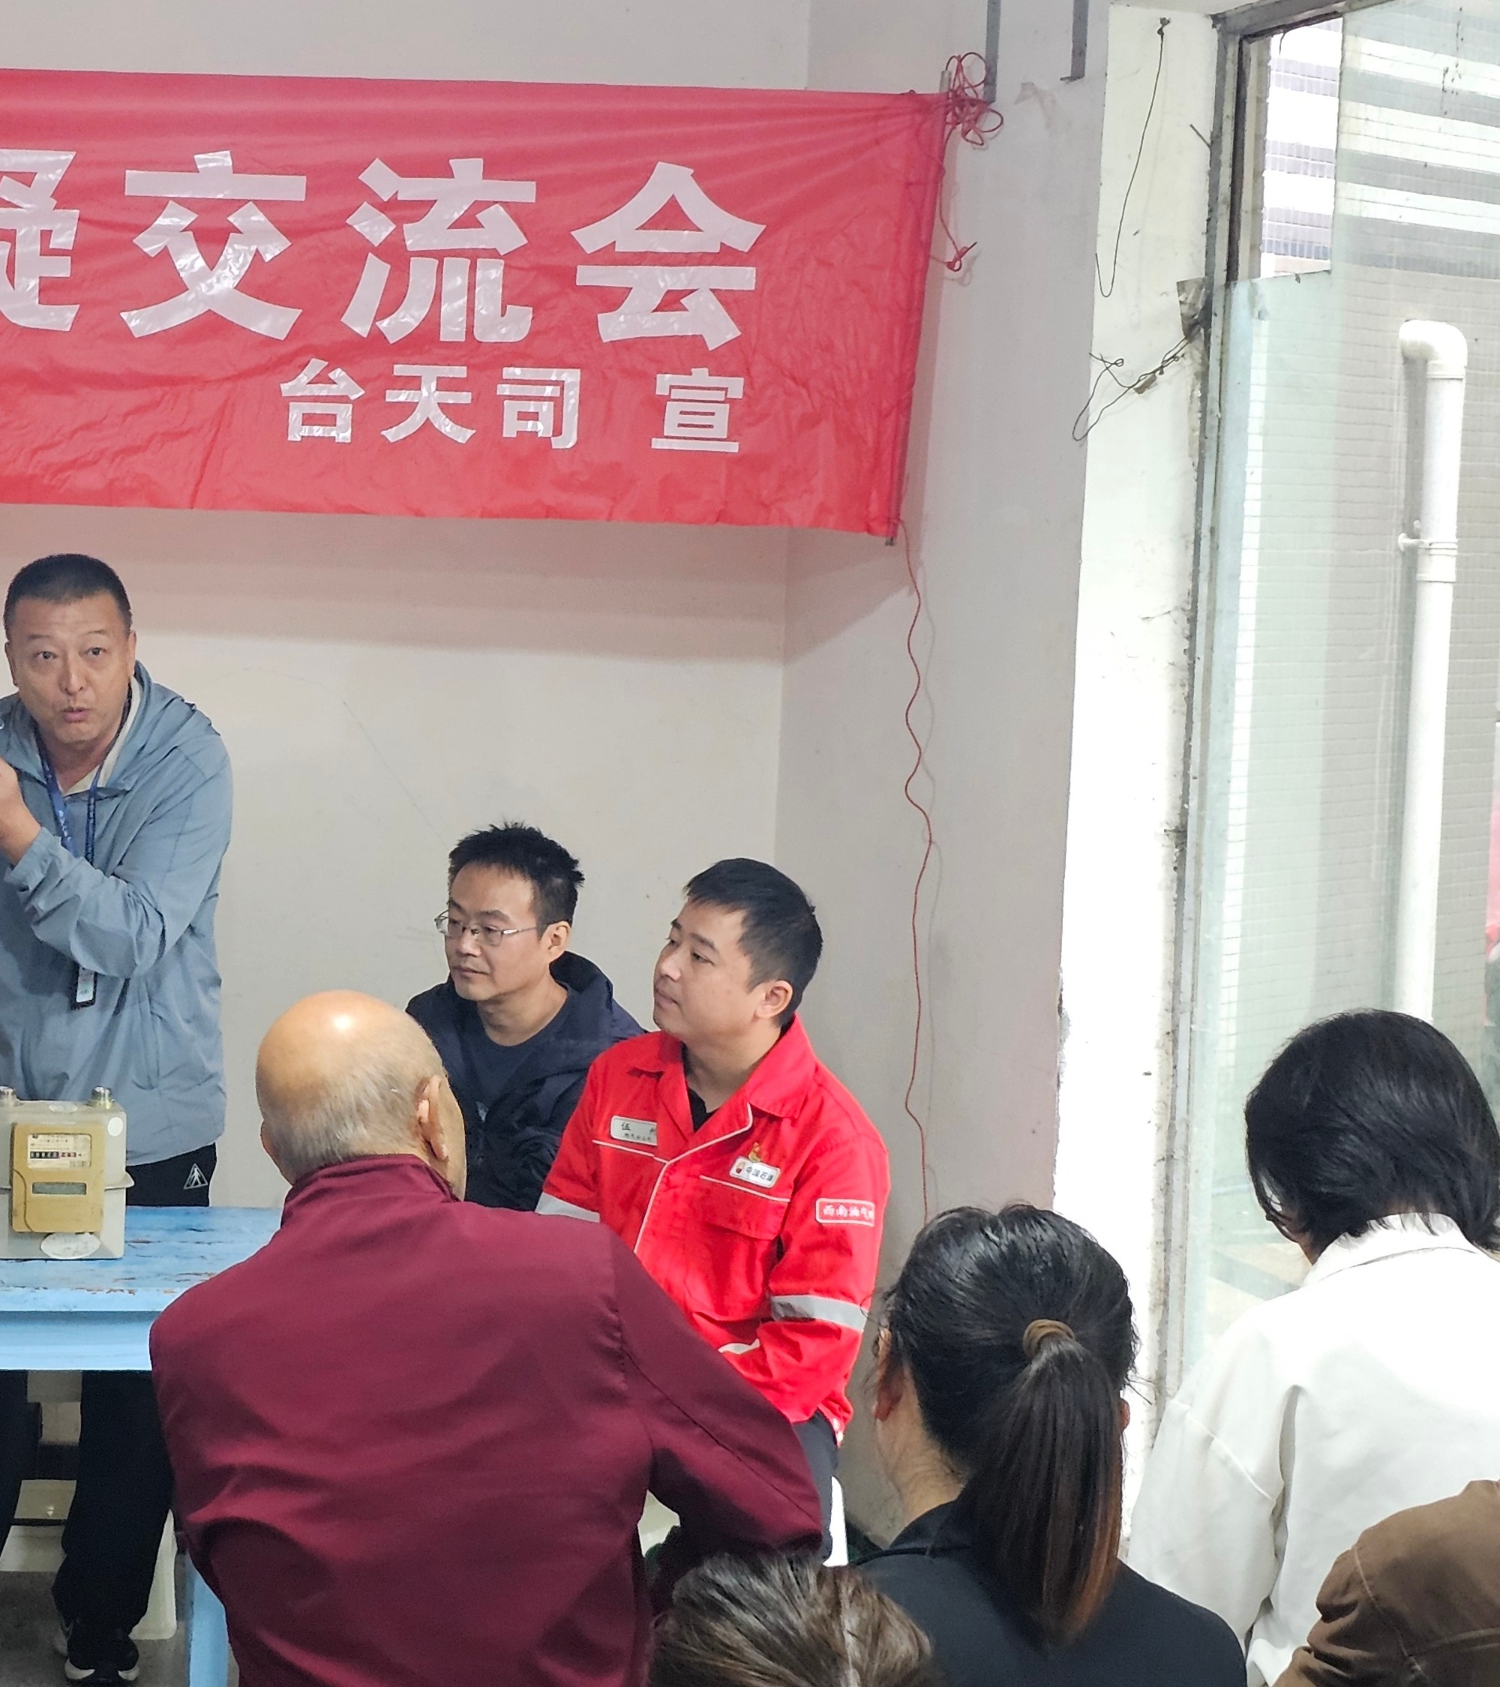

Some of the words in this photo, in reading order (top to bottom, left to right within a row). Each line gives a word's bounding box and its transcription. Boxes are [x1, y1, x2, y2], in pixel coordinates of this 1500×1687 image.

[279, 357, 583, 450] 台天司
[650, 367, 745, 454] 宣
